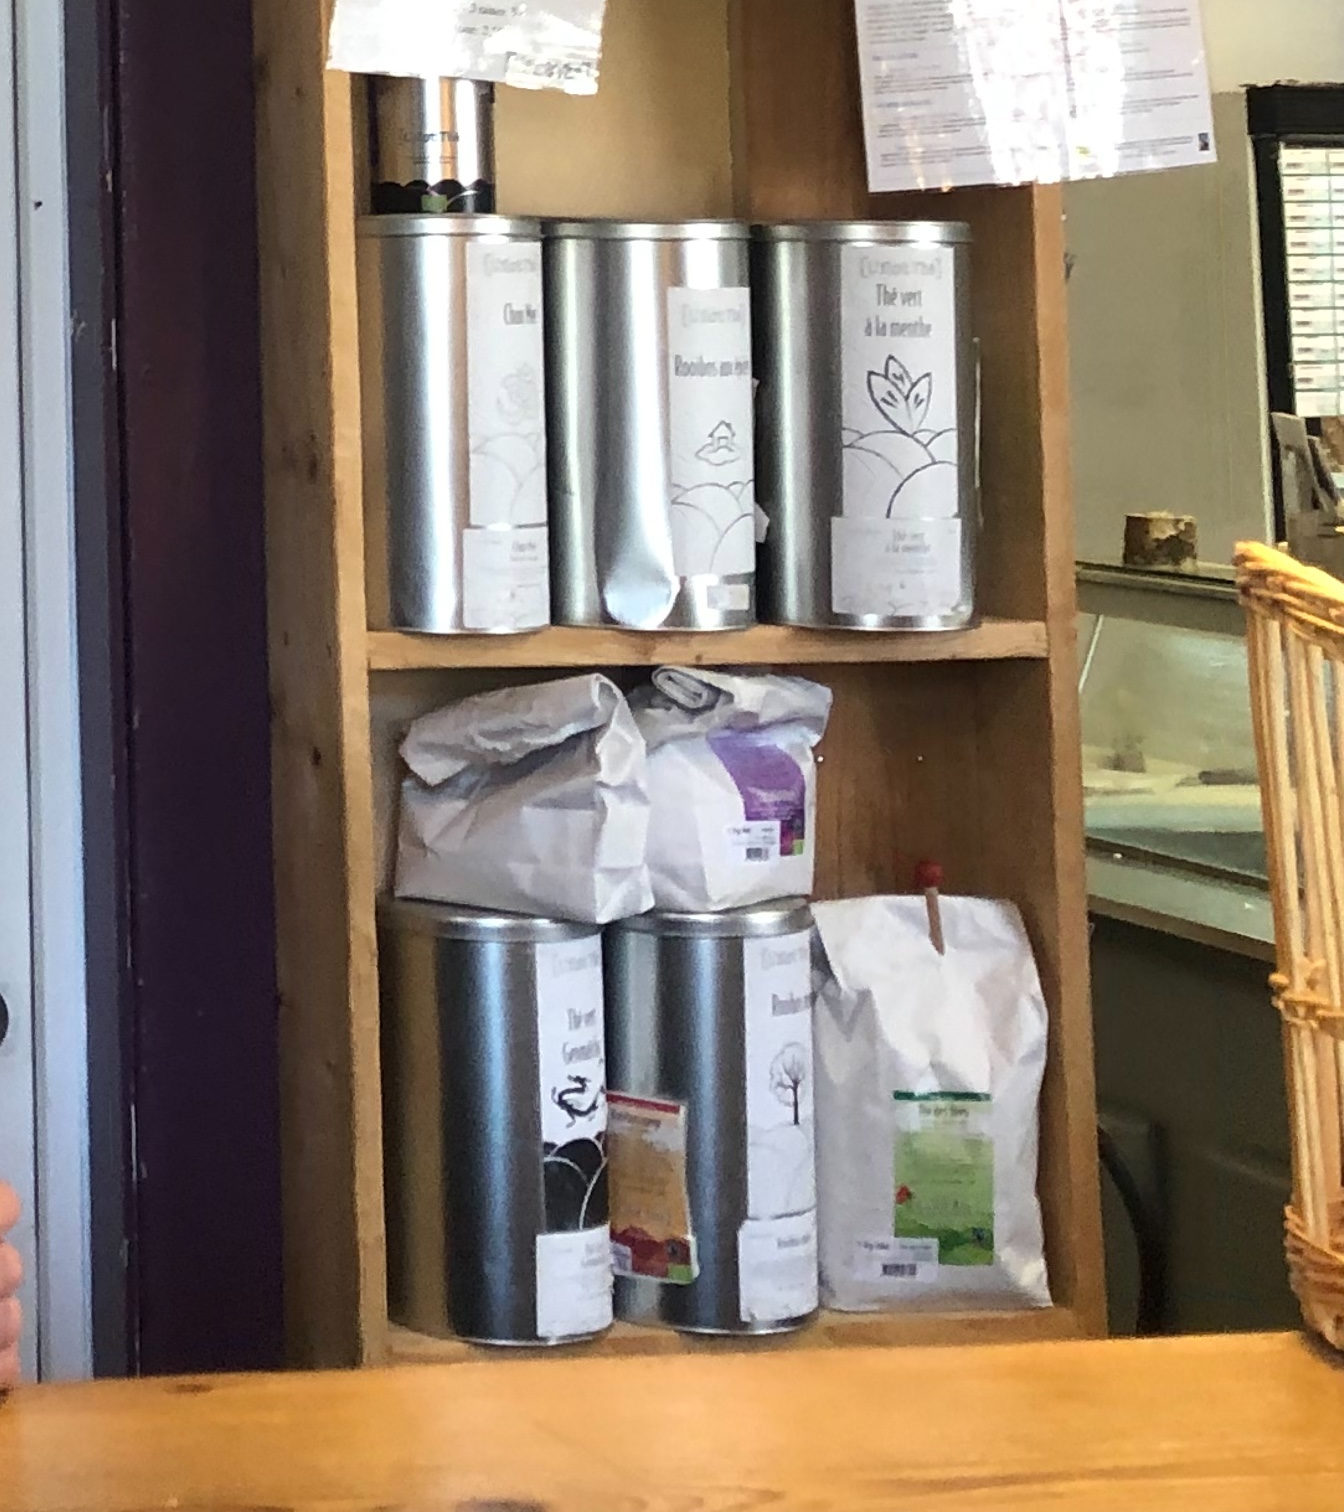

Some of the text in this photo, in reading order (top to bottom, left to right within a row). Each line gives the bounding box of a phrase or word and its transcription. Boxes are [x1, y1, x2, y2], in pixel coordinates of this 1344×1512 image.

[875, 283, 922, 307] Thé vert
[875, 315, 887, 337] la
[890, 316, 932, 337] menthe
